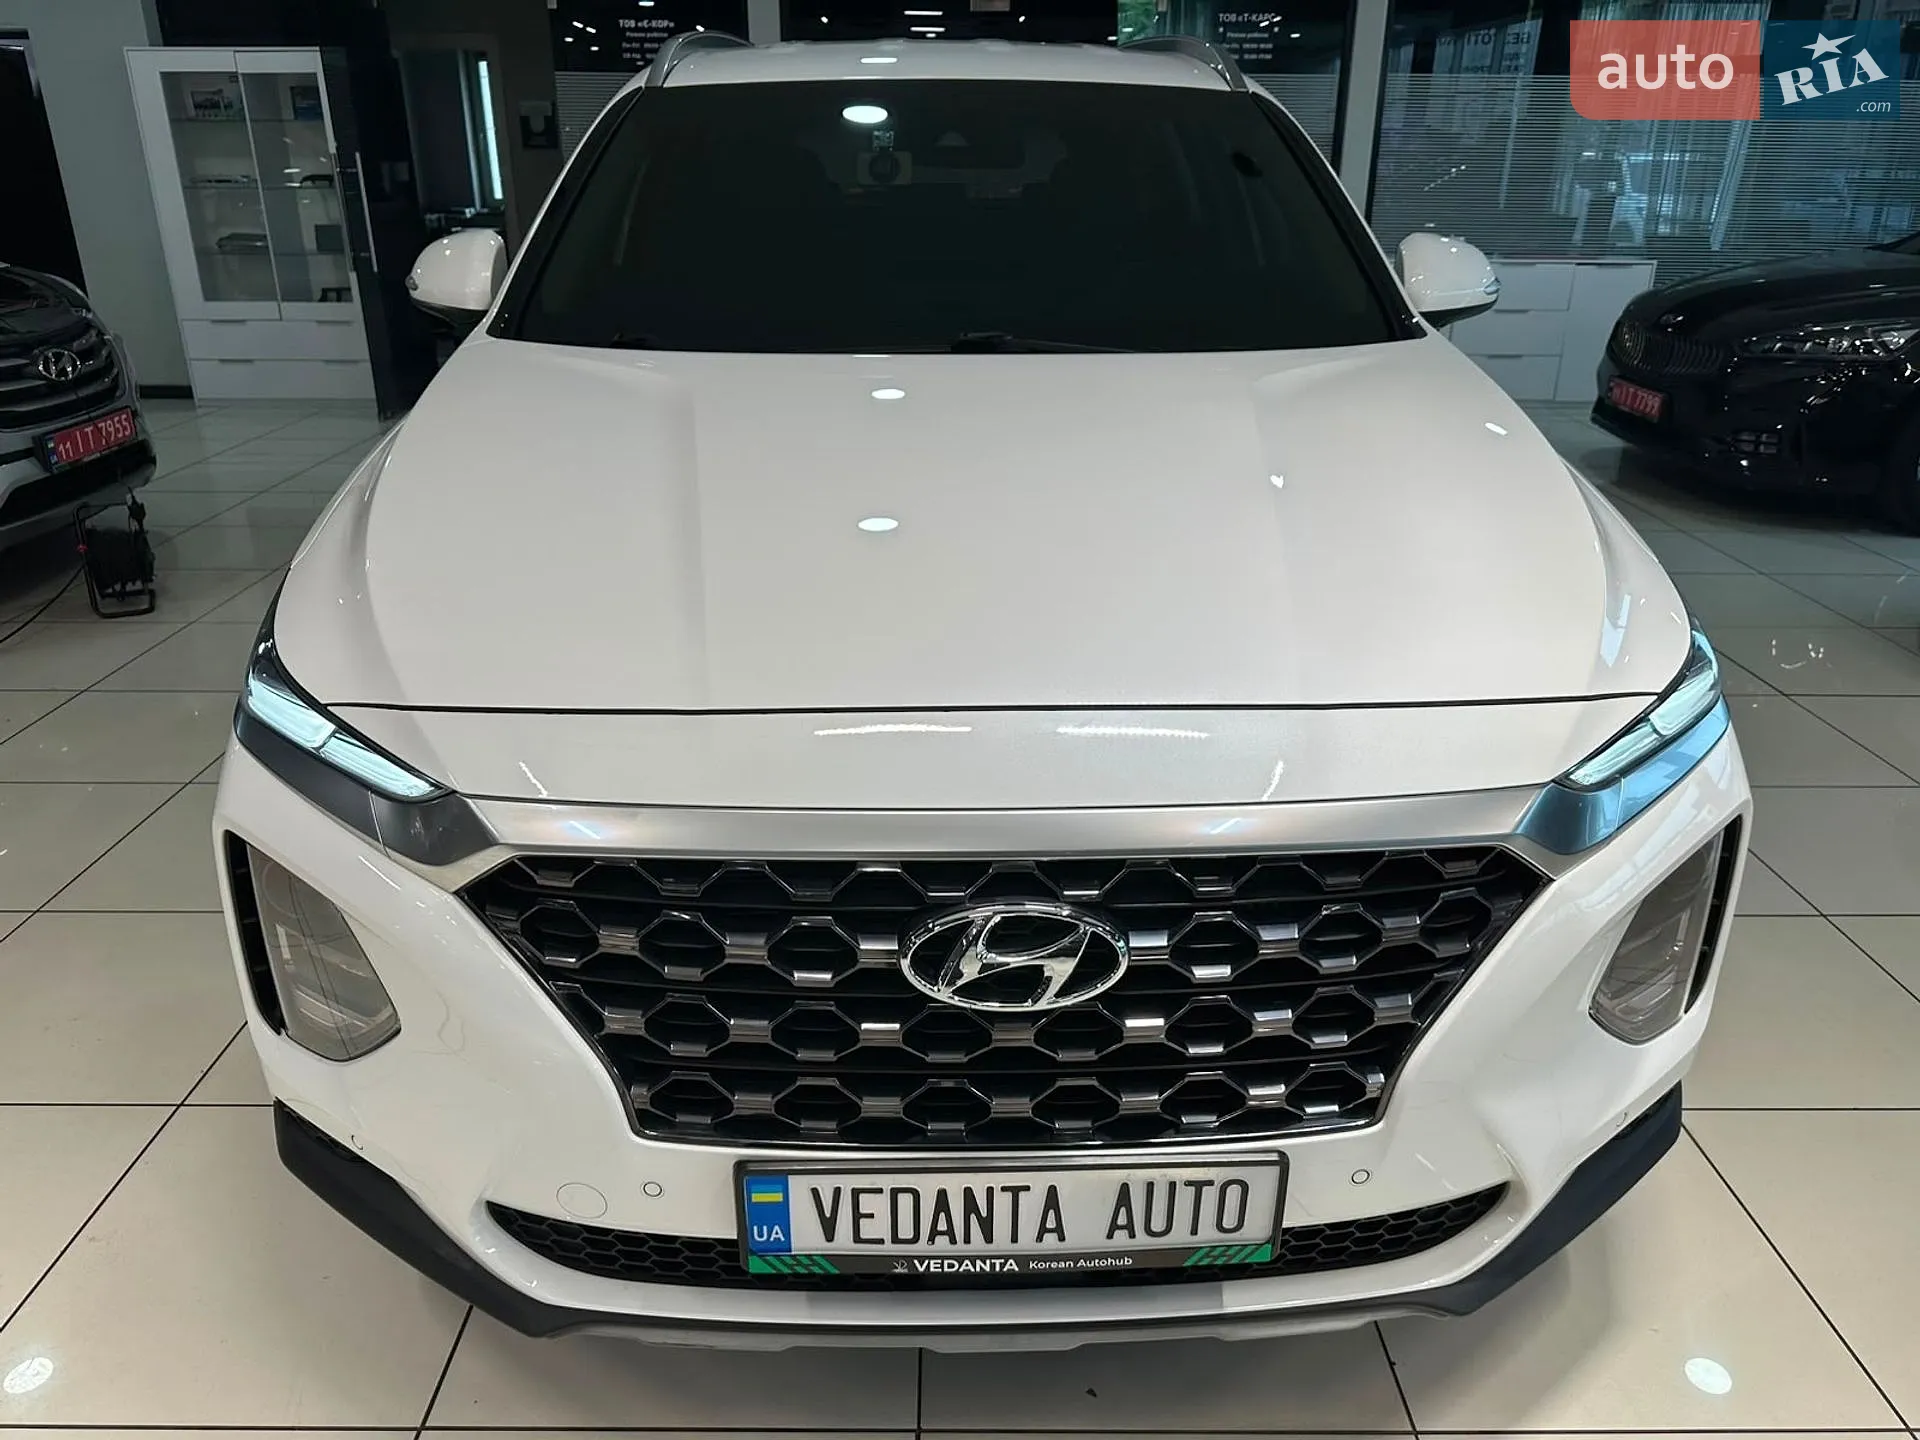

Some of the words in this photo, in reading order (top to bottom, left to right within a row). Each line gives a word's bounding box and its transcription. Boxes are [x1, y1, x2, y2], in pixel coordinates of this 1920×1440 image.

[98, 414, 131, 446] 7955
[810, 1182, 1067, 1246] VEDANTA
[1106, 1178, 1251, 1241] AUTO
[753, 1224, 785, 1243] UA
[913, 1258, 1019, 1273] VEDANTA
[1029, 1259, 1074, 1270] Korean
[1076, 1256, 1133, 1269] Autohub
